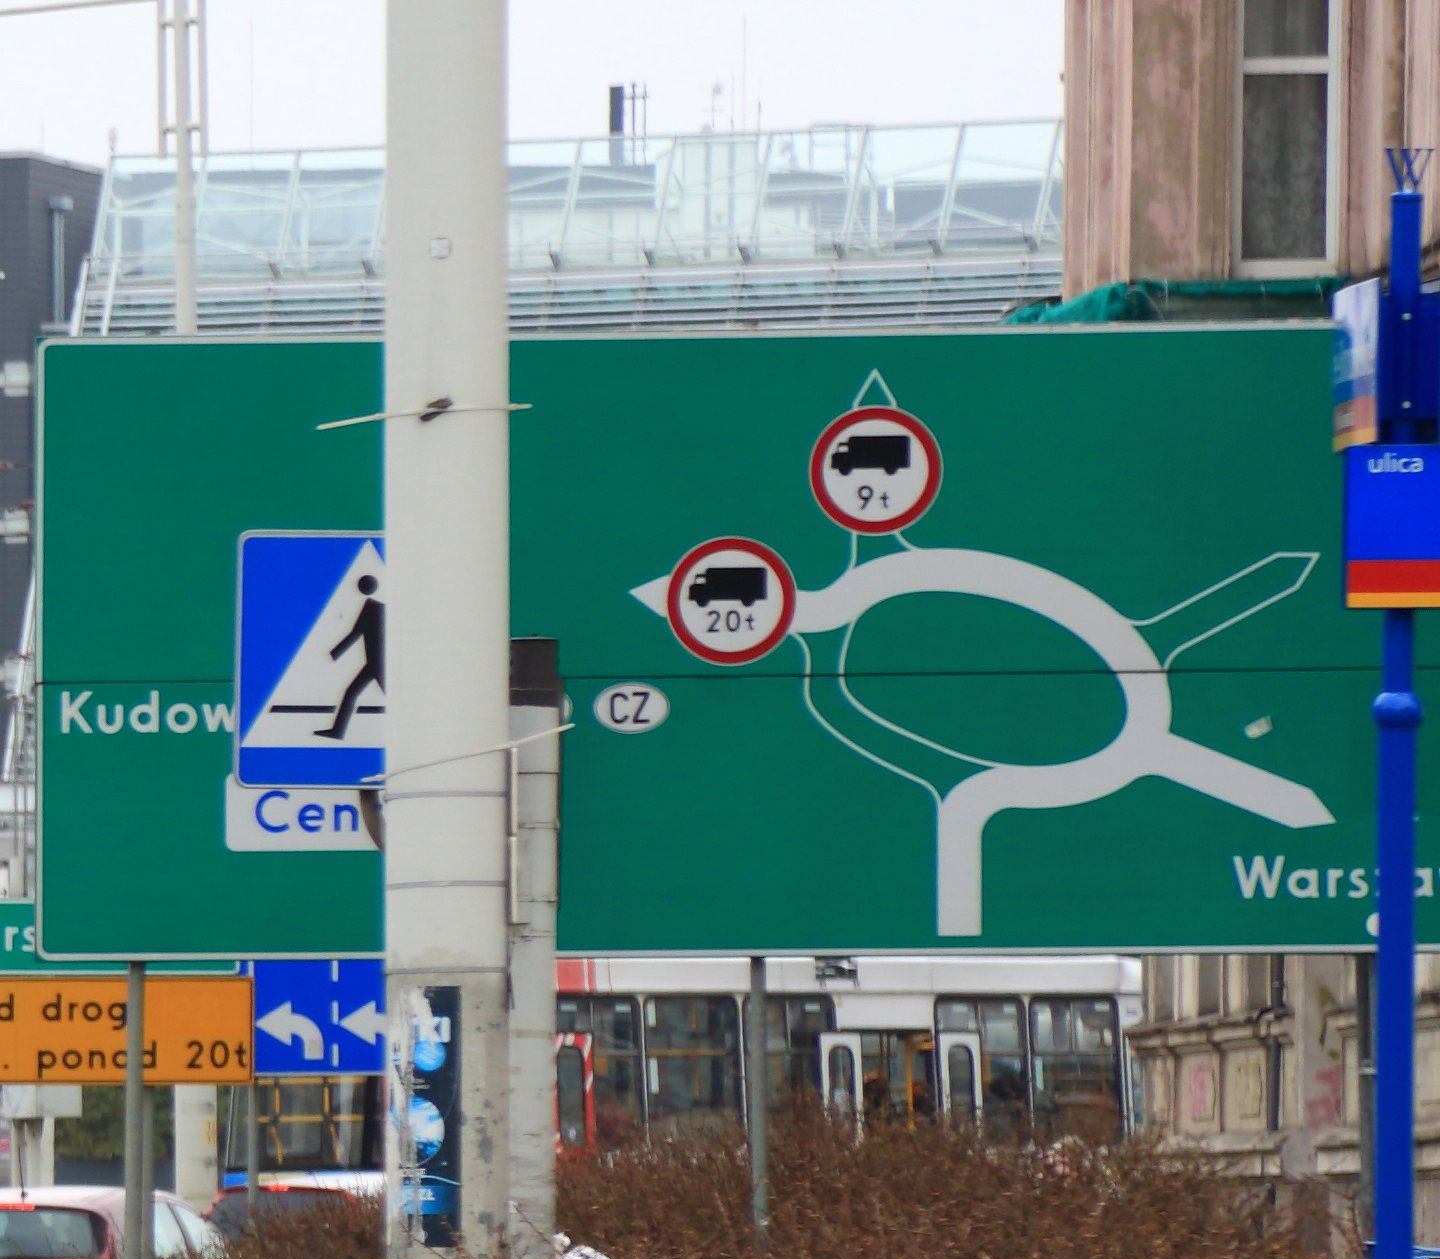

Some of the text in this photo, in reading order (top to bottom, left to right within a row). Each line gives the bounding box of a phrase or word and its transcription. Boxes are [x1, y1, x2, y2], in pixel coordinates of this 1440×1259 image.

[1368, 453, 1424, 474] ulica
[707, 610, 755, 634] 20t
[609, 692, 651, 725] CZ
[186, 1040, 247, 1069] 20t
